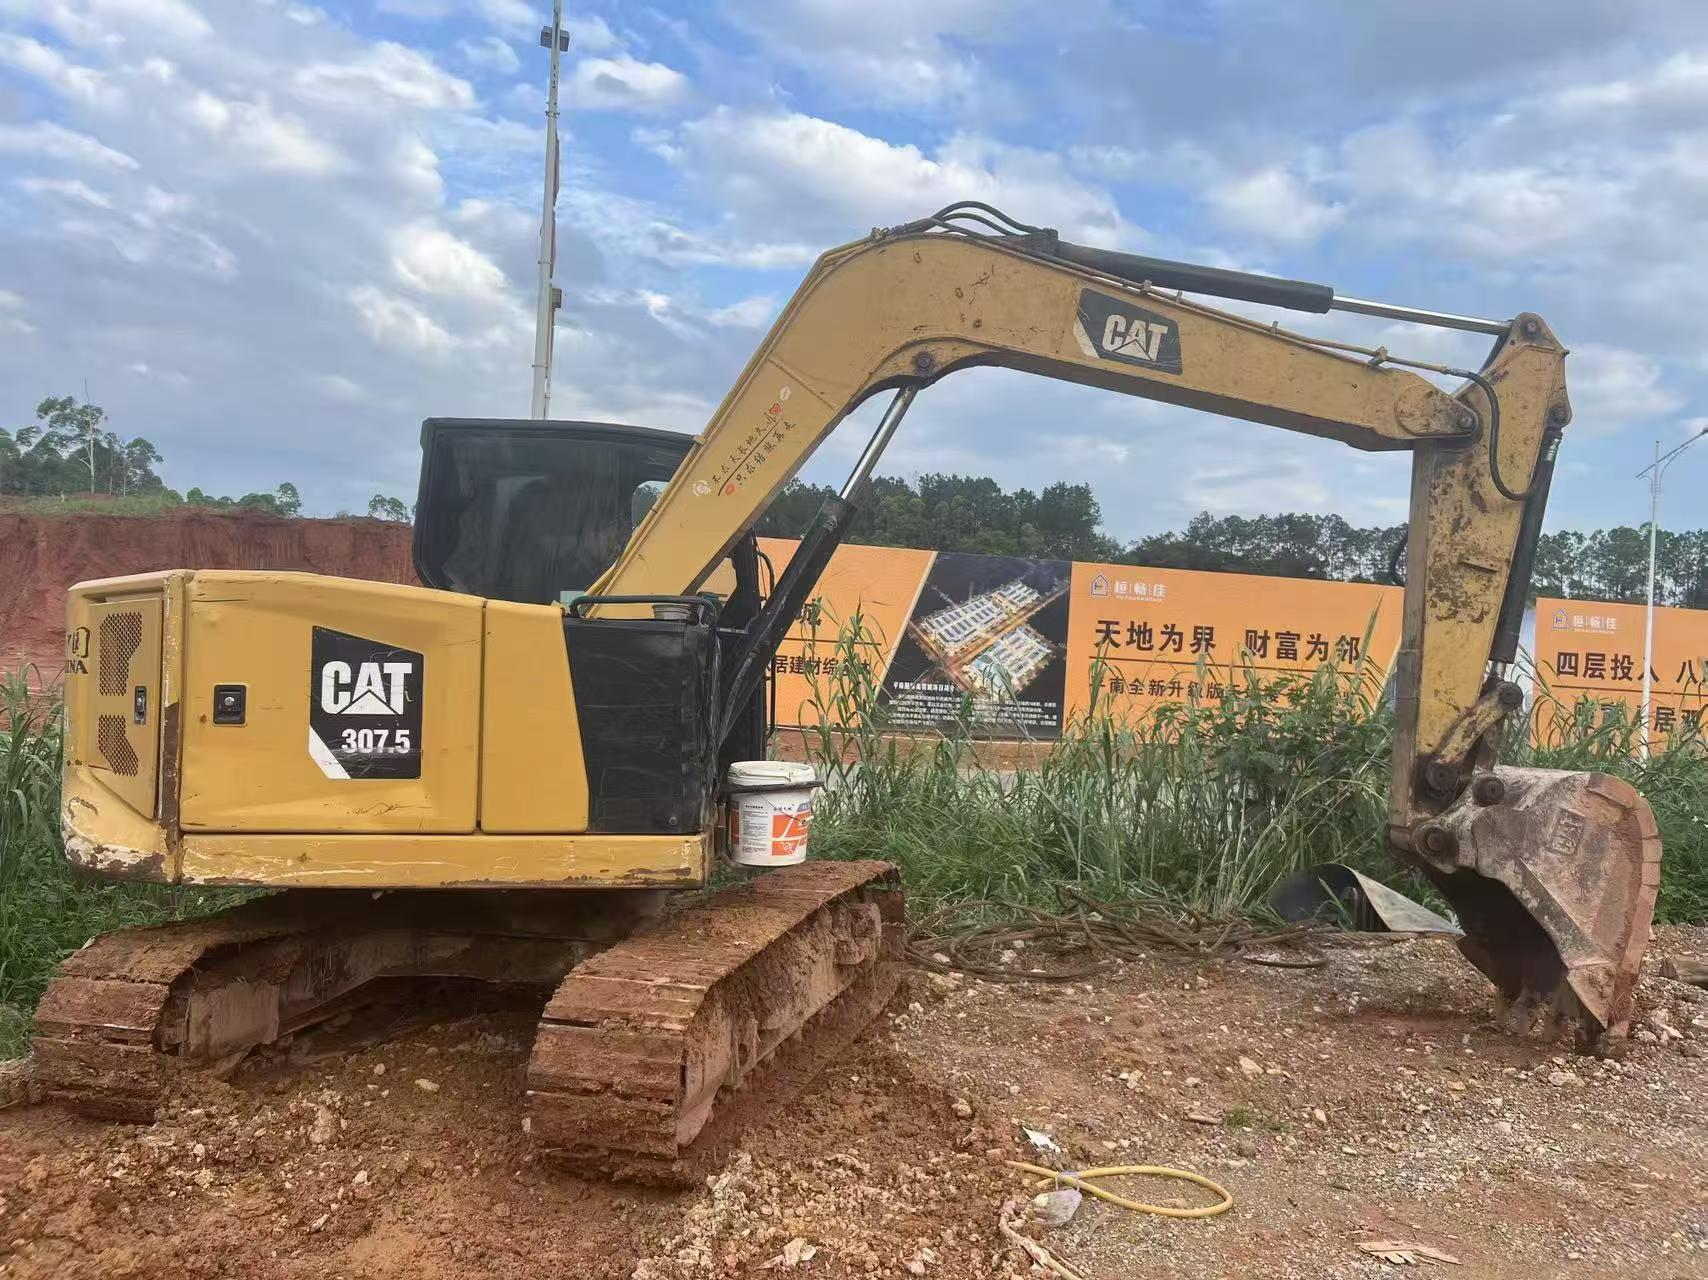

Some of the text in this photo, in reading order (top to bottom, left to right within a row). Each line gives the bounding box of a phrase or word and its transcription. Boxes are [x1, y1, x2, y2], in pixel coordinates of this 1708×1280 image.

[1102, 314, 1169, 362] CAT
[1094, 619, 1361, 664] 天地为界 财富为邻
[321, 660, 412, 715] CAT
[341, 728, 411, 754] 307.5
